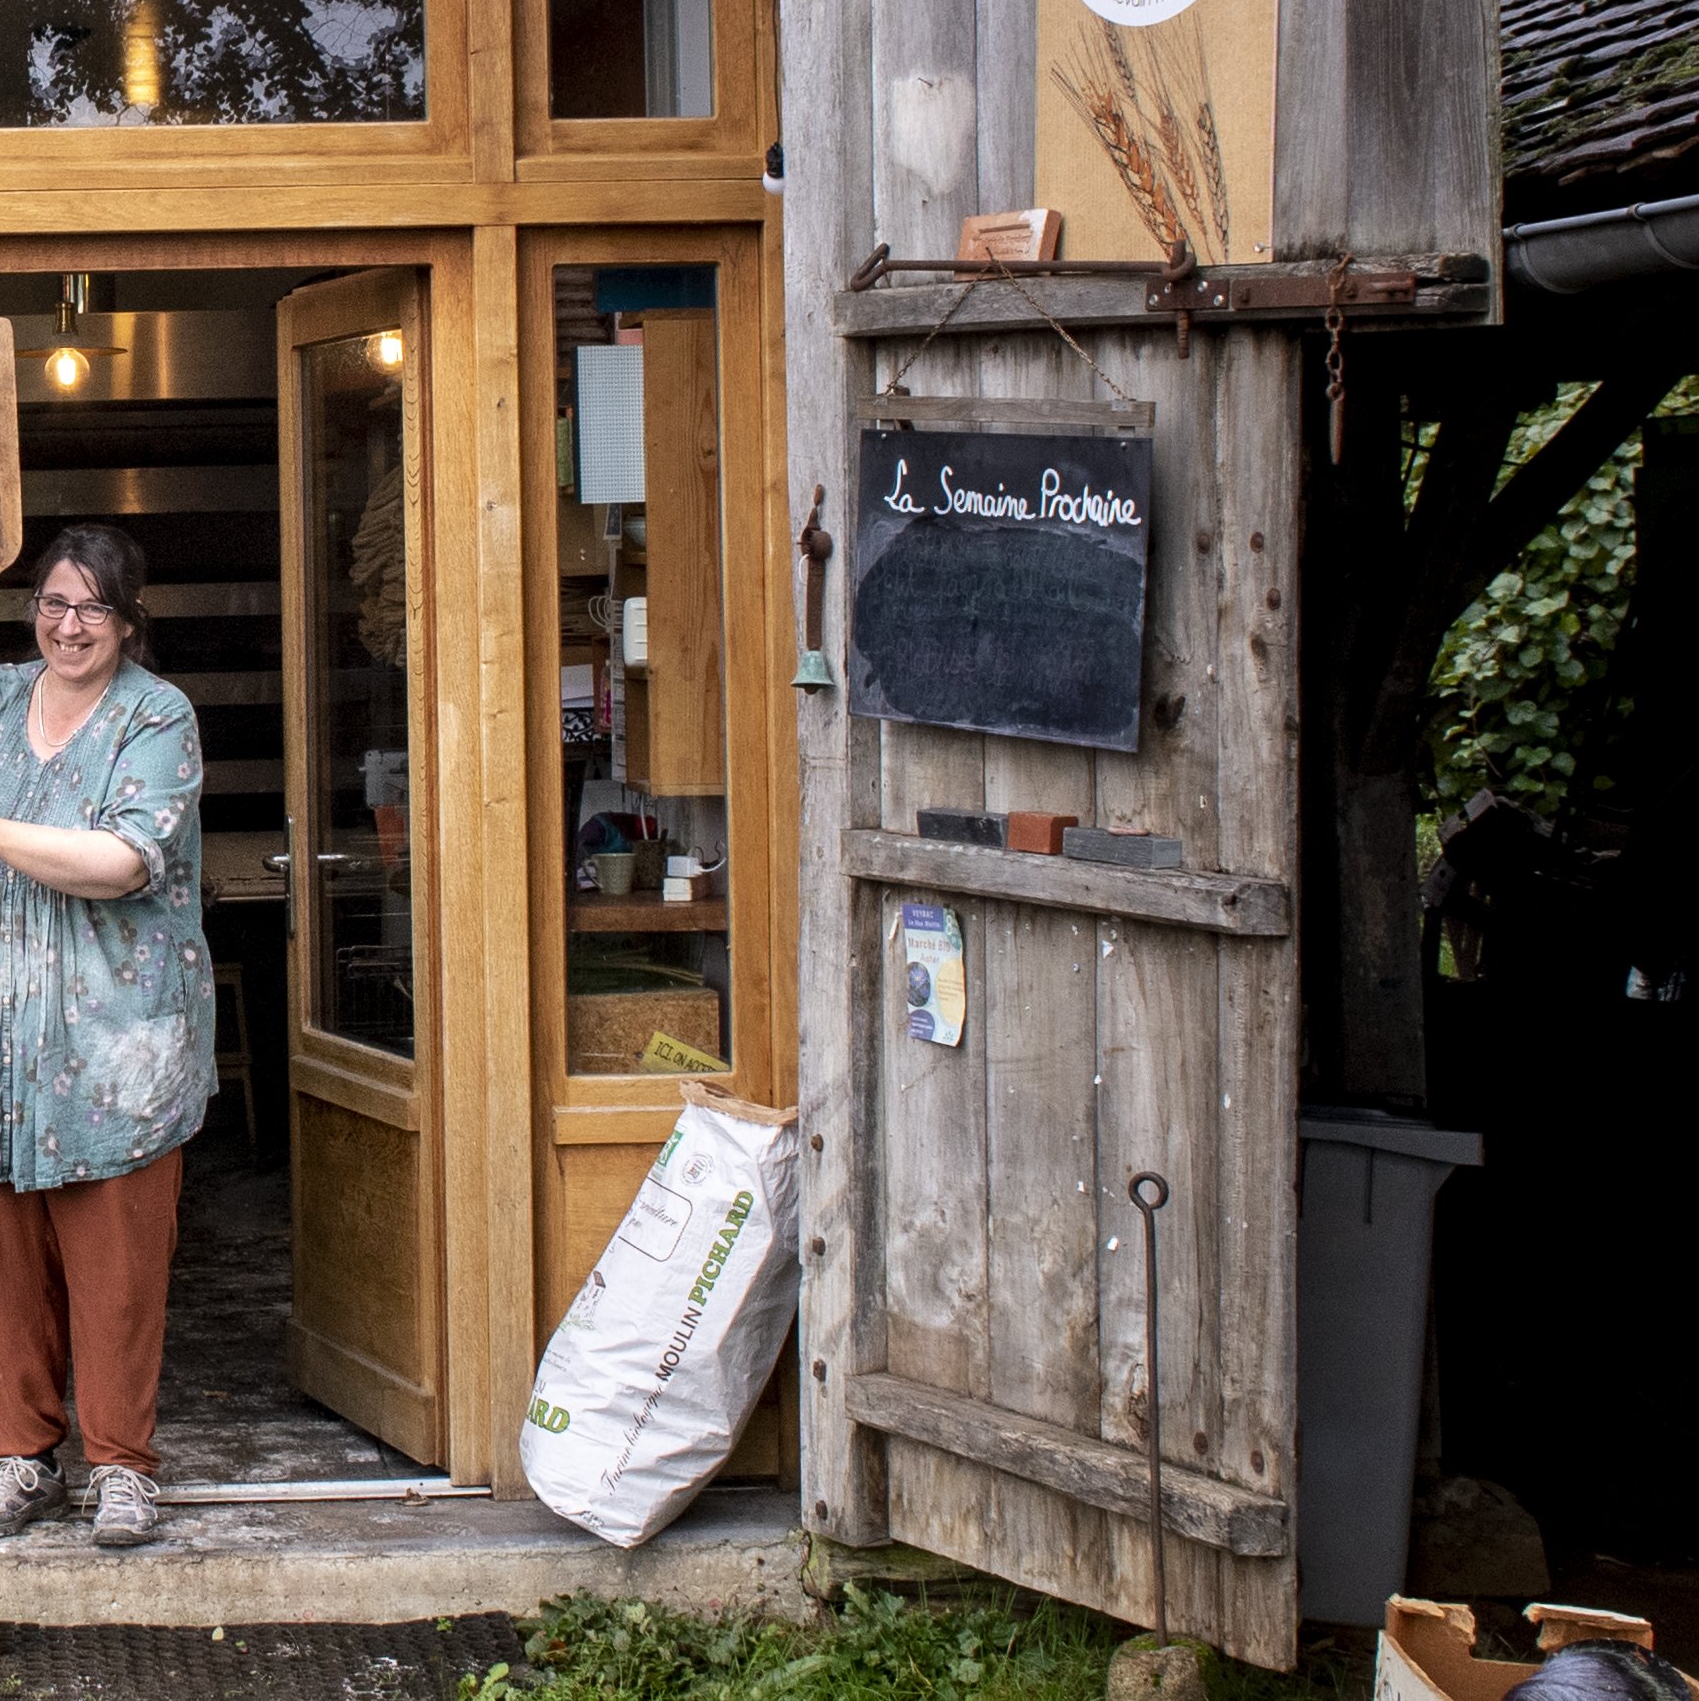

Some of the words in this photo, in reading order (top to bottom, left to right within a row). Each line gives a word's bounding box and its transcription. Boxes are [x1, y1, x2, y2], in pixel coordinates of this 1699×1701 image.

[884, 459, 925, 514] La
[934, 465, 1037, 521] Semaine
[1039, 467, 1143, 528] Prochaine
[655, 1306, 703, 1383] MOULIN
[688, 1190, 755, 1308] PICHARD
